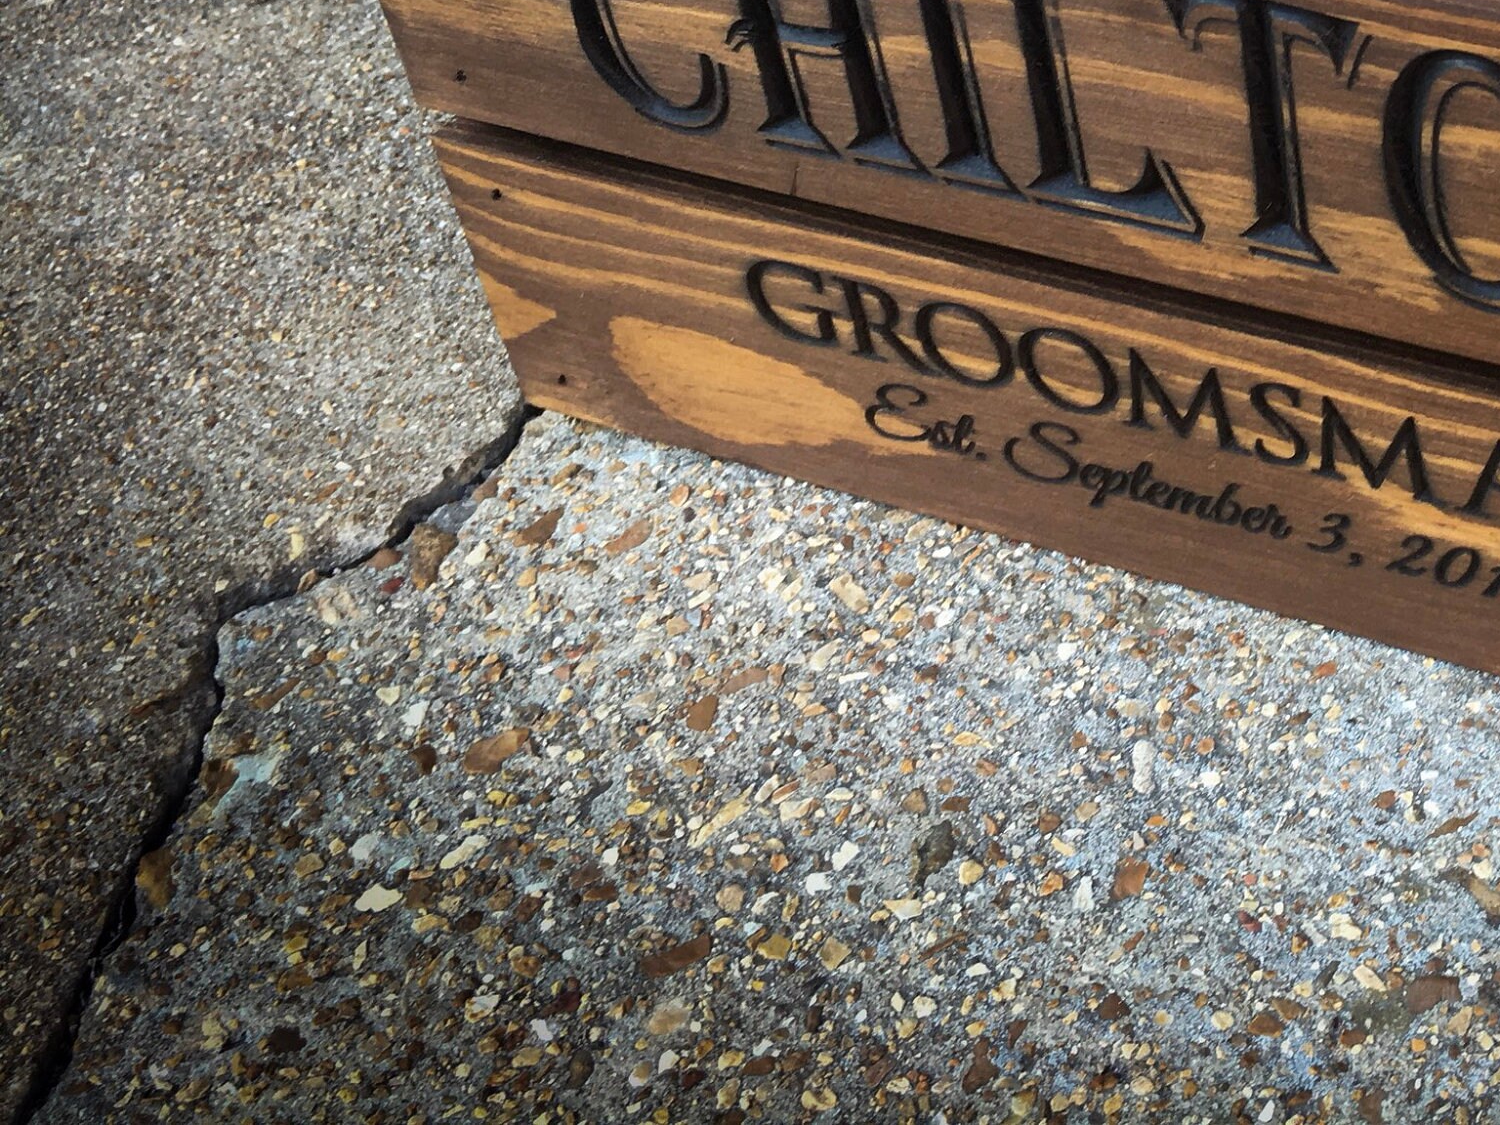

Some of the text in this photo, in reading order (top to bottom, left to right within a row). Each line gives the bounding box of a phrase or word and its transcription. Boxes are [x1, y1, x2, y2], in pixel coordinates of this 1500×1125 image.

[865, 383, 988, 462] Est.
[1003, 420, 1293, 541] September
[1307, 512, 1364, 567] 3,
